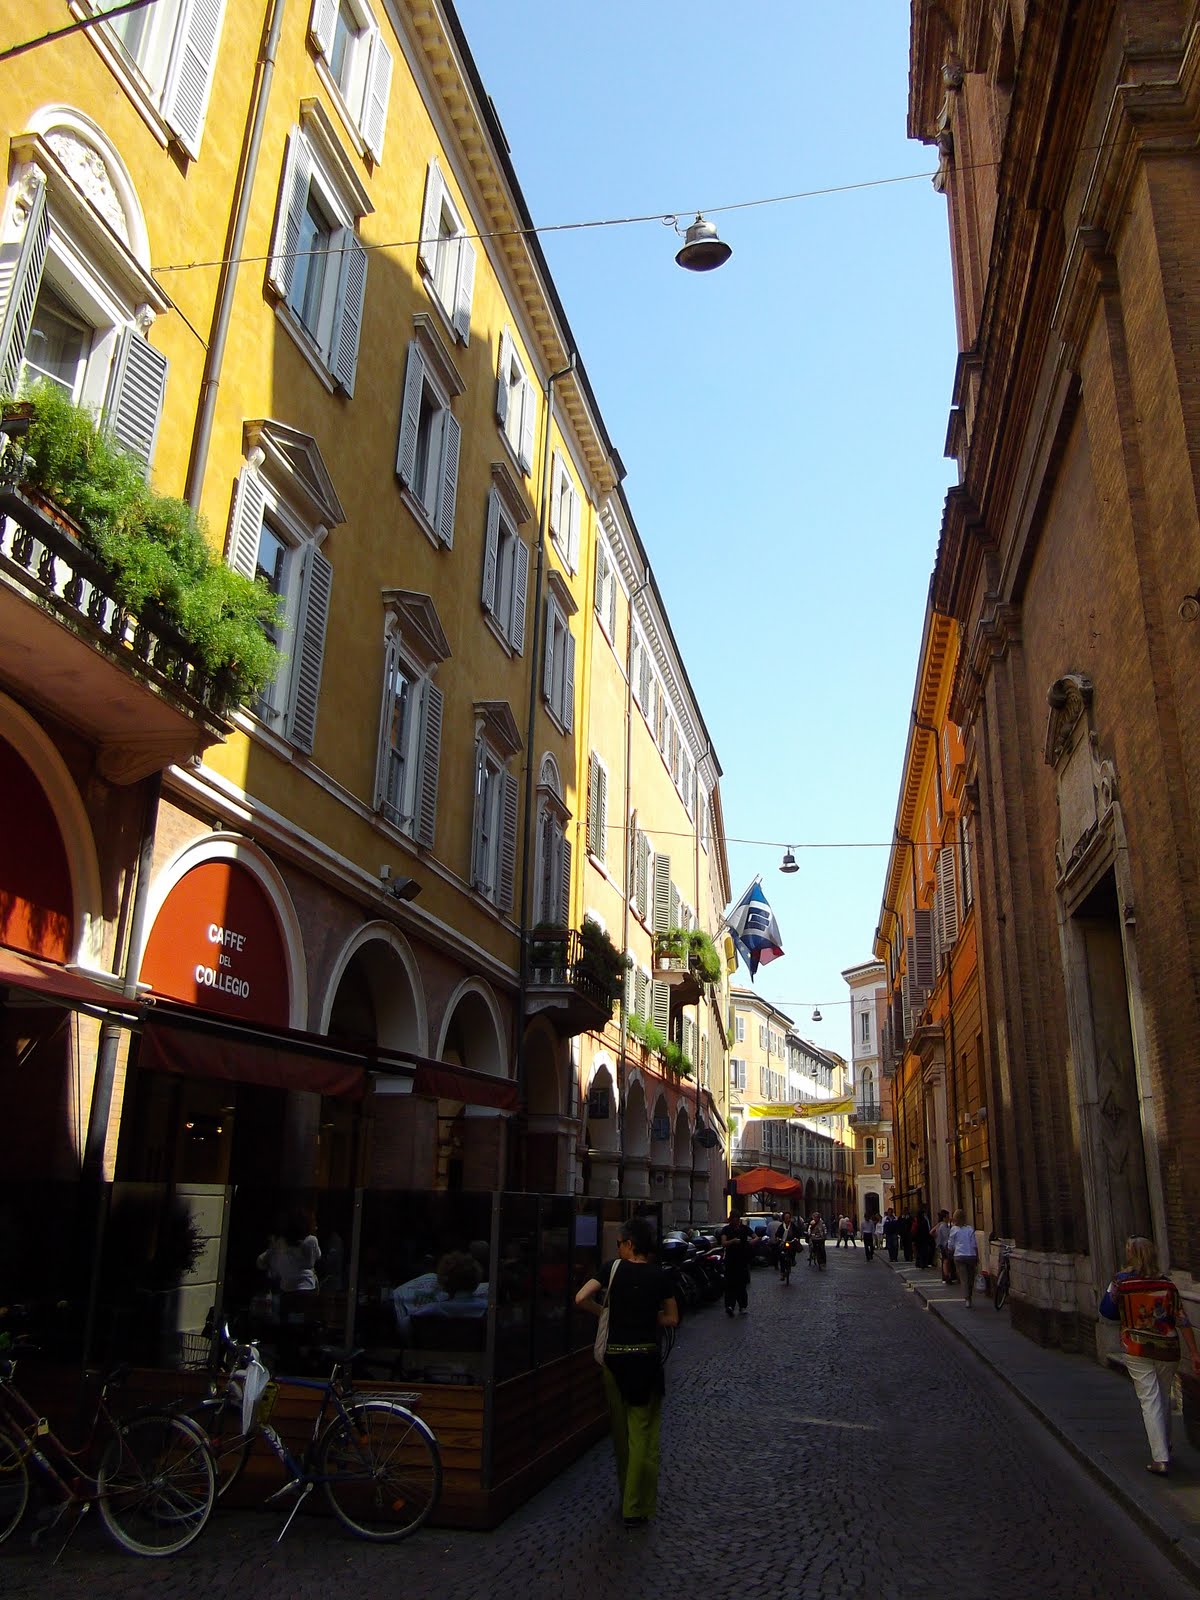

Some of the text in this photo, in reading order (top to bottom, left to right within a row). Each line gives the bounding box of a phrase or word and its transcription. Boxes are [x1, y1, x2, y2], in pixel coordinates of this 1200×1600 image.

[208, 923, 246, 952] CAFFE'
[219, 954, 232, 968] DEL
[195, 964, 250, 999] COLLEGIO
